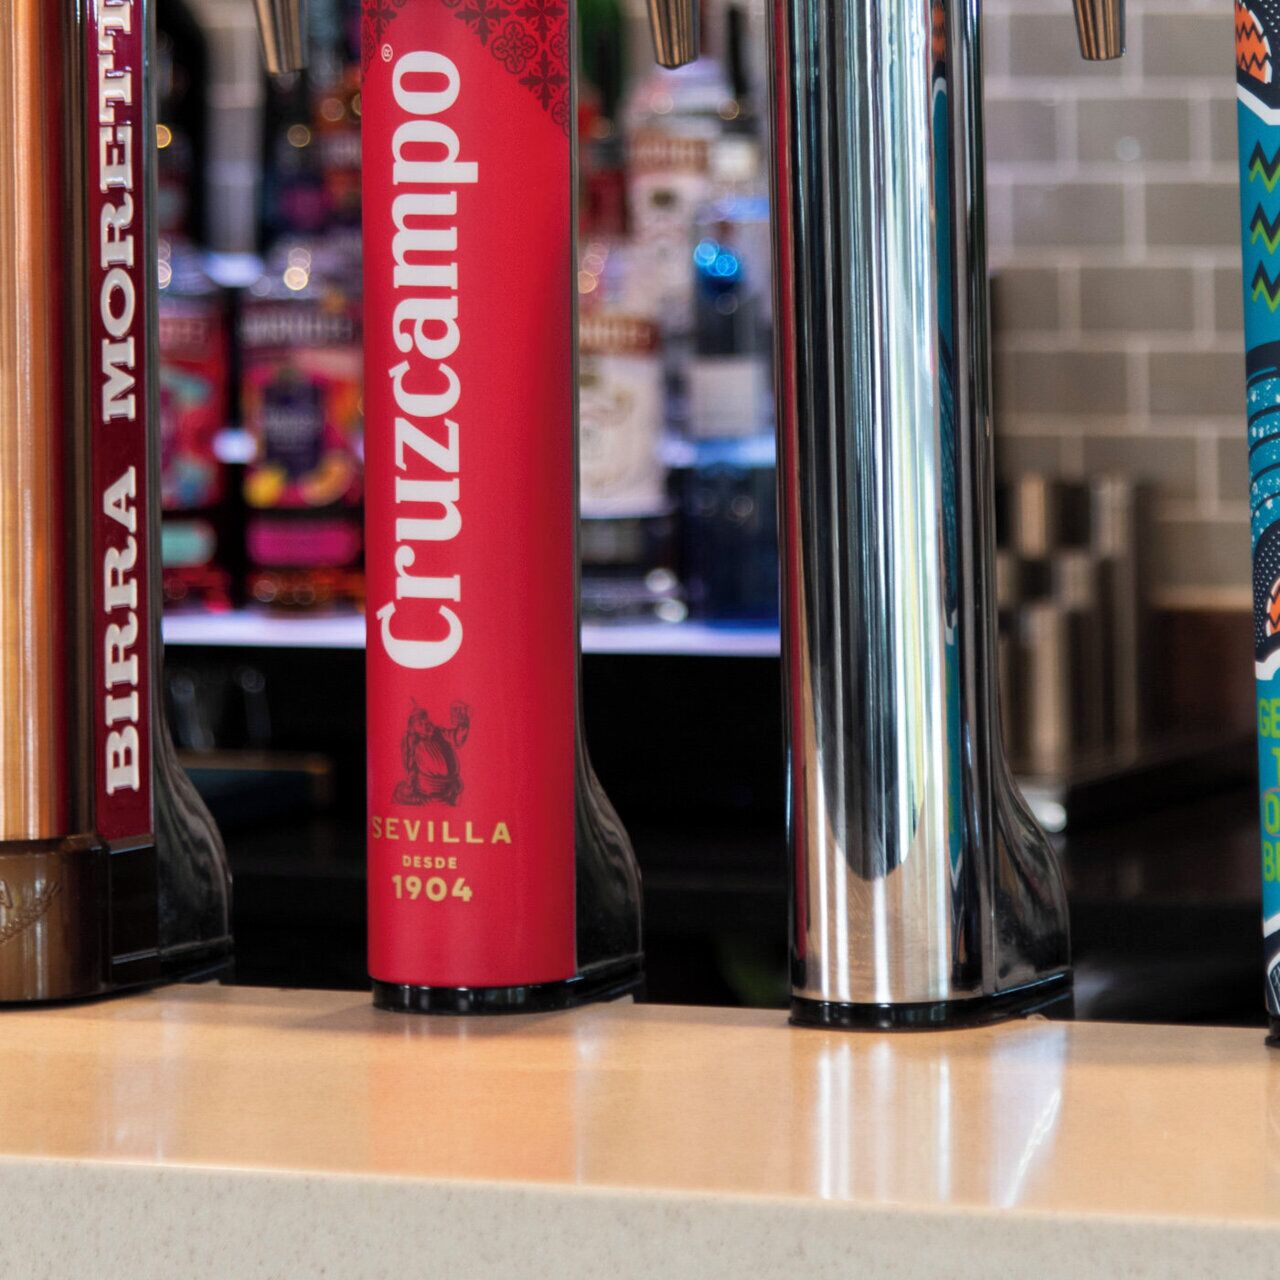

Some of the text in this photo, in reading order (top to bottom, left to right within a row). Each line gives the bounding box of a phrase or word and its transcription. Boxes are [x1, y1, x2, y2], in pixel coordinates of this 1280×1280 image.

[377, 49, 478, 669] Cruzcampo
[102, 465, 141, 795] BIRRA
[372, 816, 513, 844] SEVILLA
[402, 855, 458, 870] DESDE
[392, 874, 474, 902] 1904
